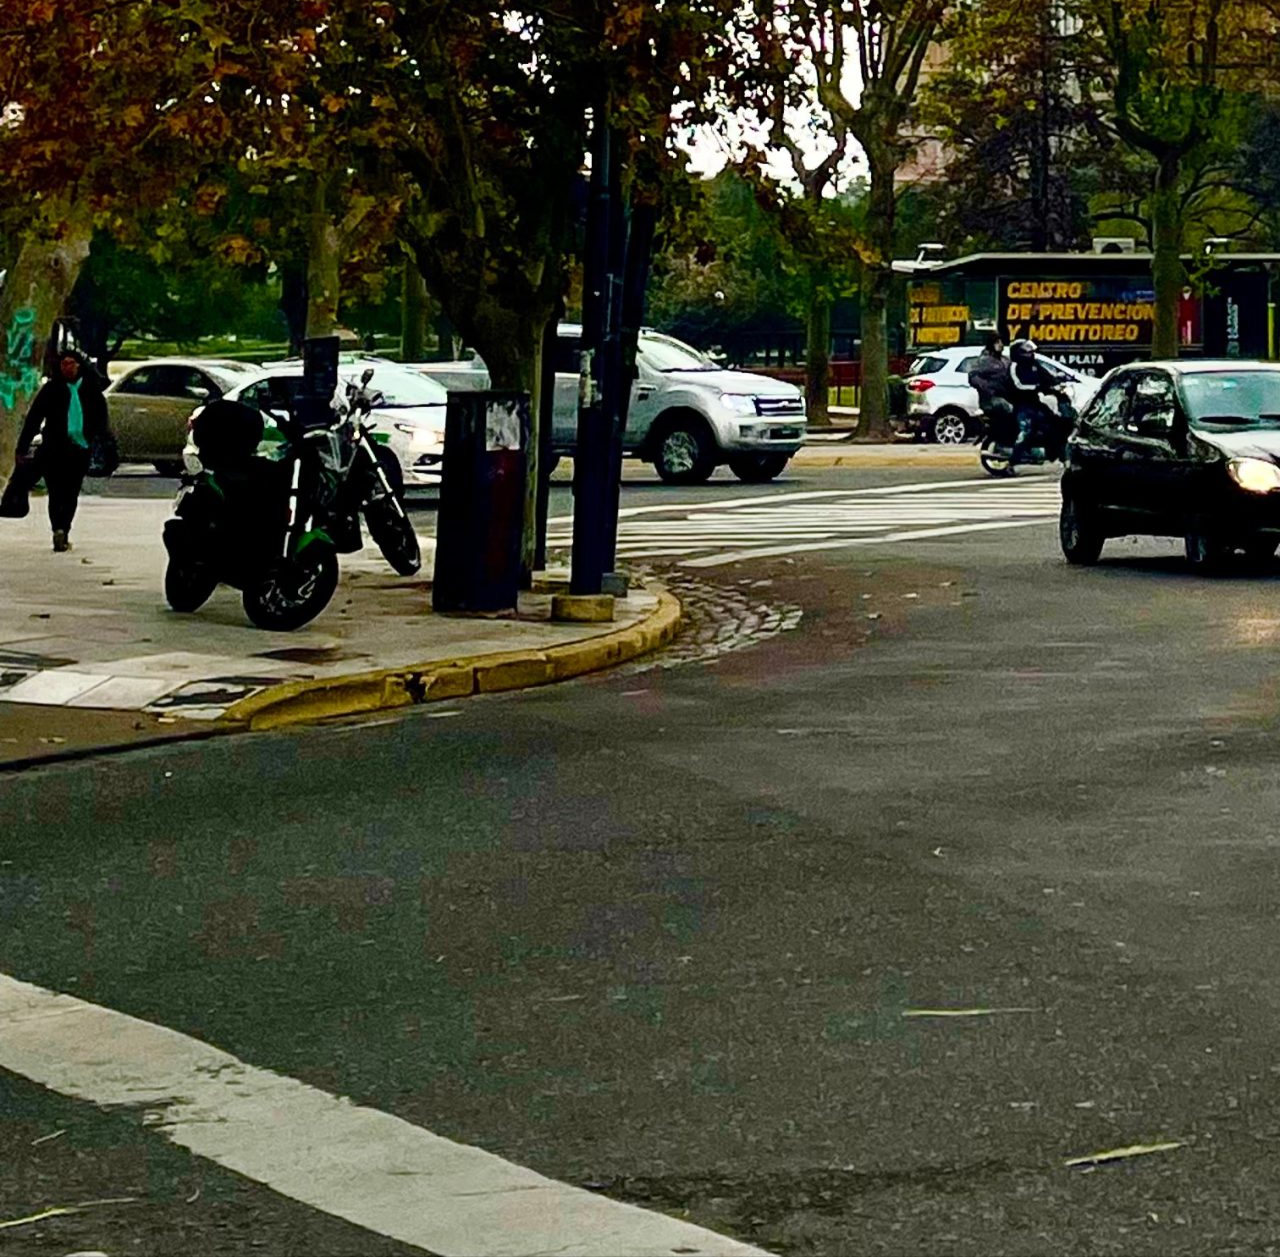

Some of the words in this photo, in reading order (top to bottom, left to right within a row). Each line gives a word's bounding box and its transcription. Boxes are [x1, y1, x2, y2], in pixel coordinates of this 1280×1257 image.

[1007, 282, 1082, 299] CENTRO
[1006, 303, 1032, 320] DE
[1007, 324, 1021, 341] Y
[1029, 324, 1139, 341] MONITOREO
[1069, 354, 1104, 365] PLATA
